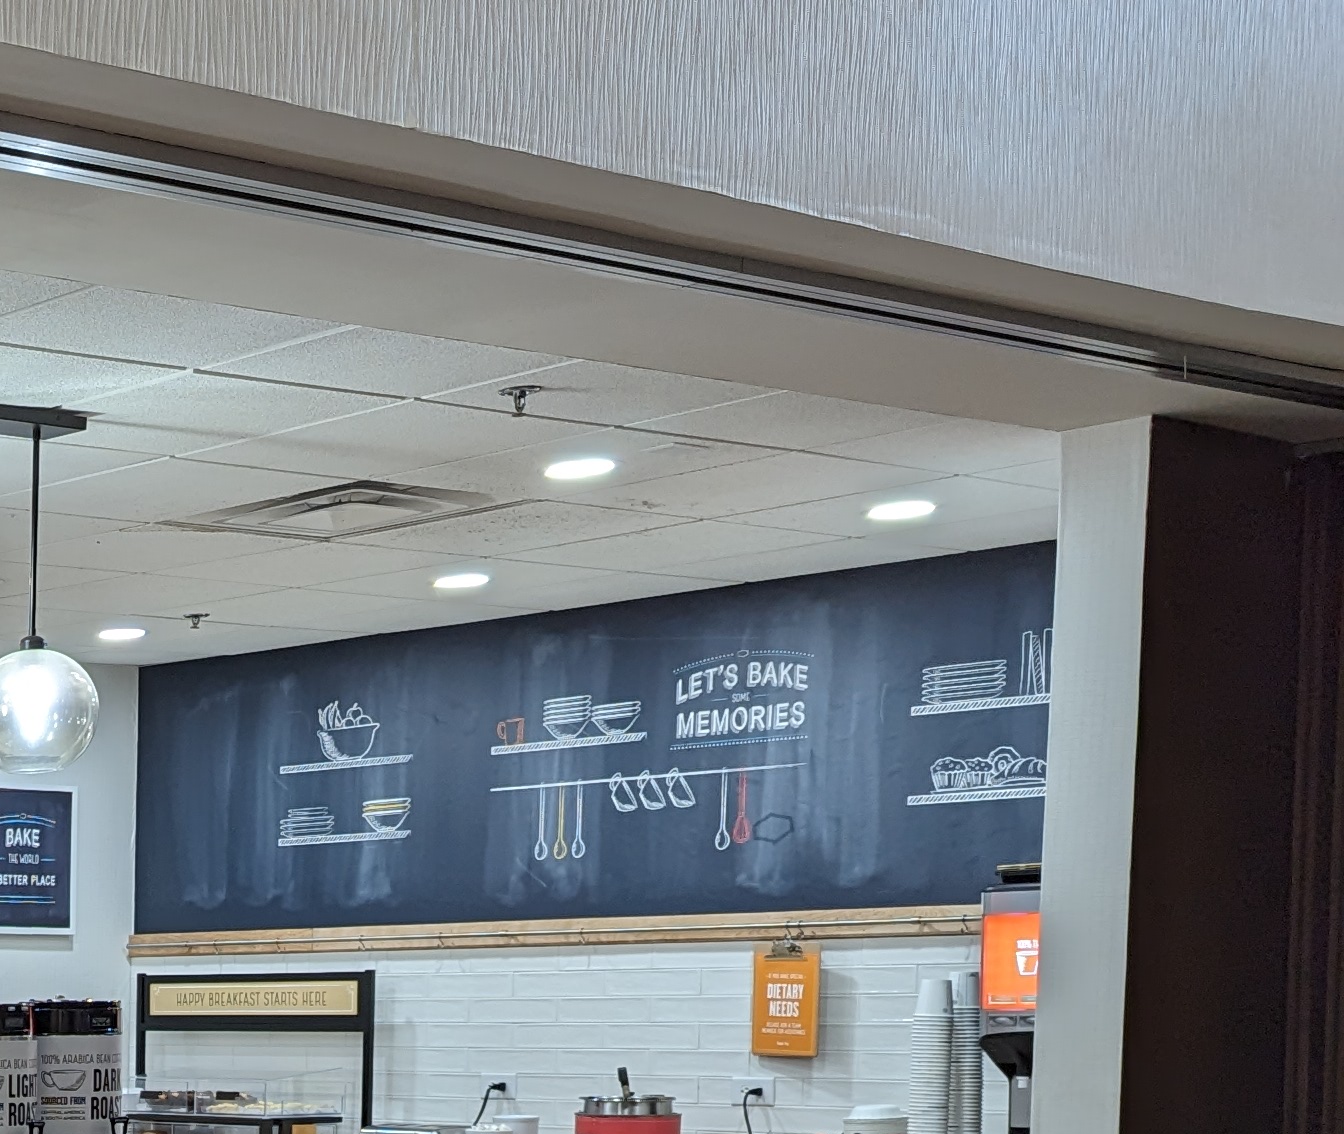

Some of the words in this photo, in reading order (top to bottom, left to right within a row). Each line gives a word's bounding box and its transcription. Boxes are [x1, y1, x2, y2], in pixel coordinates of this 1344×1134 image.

[675, 663, 738, 705] LET'S
[746, 661, 809, 691] BAKE
[731, 692, 750, 703] SOME
[675, 701, 805, 739] MEMORIES
[5, 828, 40, 848] BAKE
[8, 853, 18, 864] THE
[19, 853, 40, 865] WORLD
[30, 874, 56, 887] PLACE
[176, 992, 205, 1007] HAPPY
[208, 991, 261, 1007] BREAKFAST
[263, 991, 298, 1006] STARTS
[302, 991, 327, 1006] HERE
[767, 983, 804, 999] DIETARY
[769, 1000, 800, 1017] NEEDS
[13, 1059, 28, 1069] BEAN
[41, 1054, 60, 1064] 100%
[62, 1053, 94, 1064] ARABICA
[96, 1053, 111, 1064] BEAN
[9, 1073, 37, 1098] LIGHT
[93, 1068, 122, 1092] DARK
[9, 1102, 38, 1127] ROAS
[90, 1095, 122, 1120] ROAST
